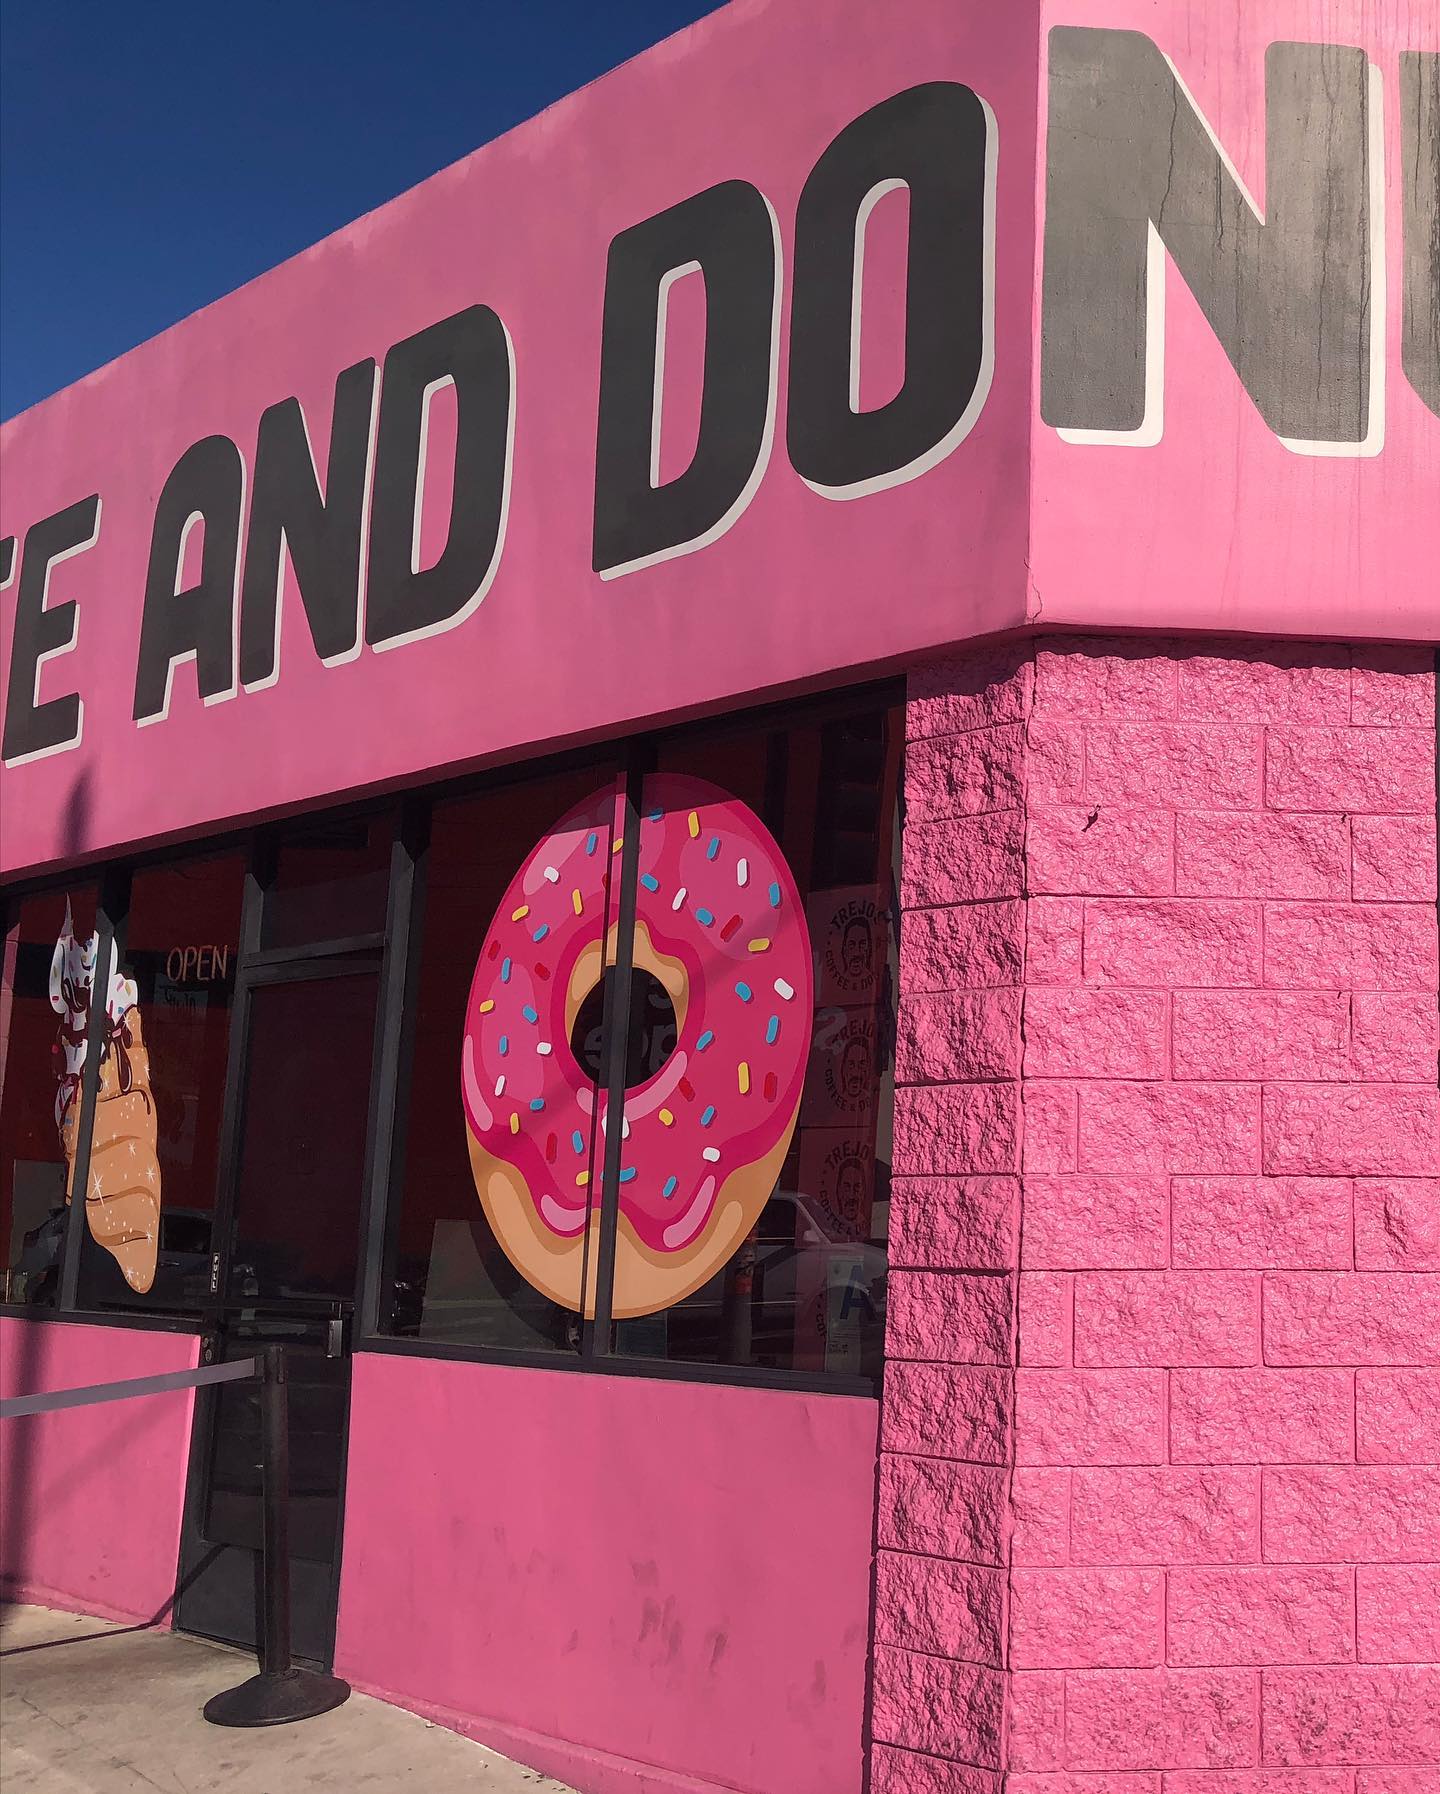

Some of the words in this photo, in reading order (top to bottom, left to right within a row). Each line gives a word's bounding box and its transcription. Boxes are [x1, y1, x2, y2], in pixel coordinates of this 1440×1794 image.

[0, 494, 102, 768] E
[132, 304, 516, 728] AND
[166, 945, 228, 981] OPEN
[825, 950, 849, 991] COFFEE
